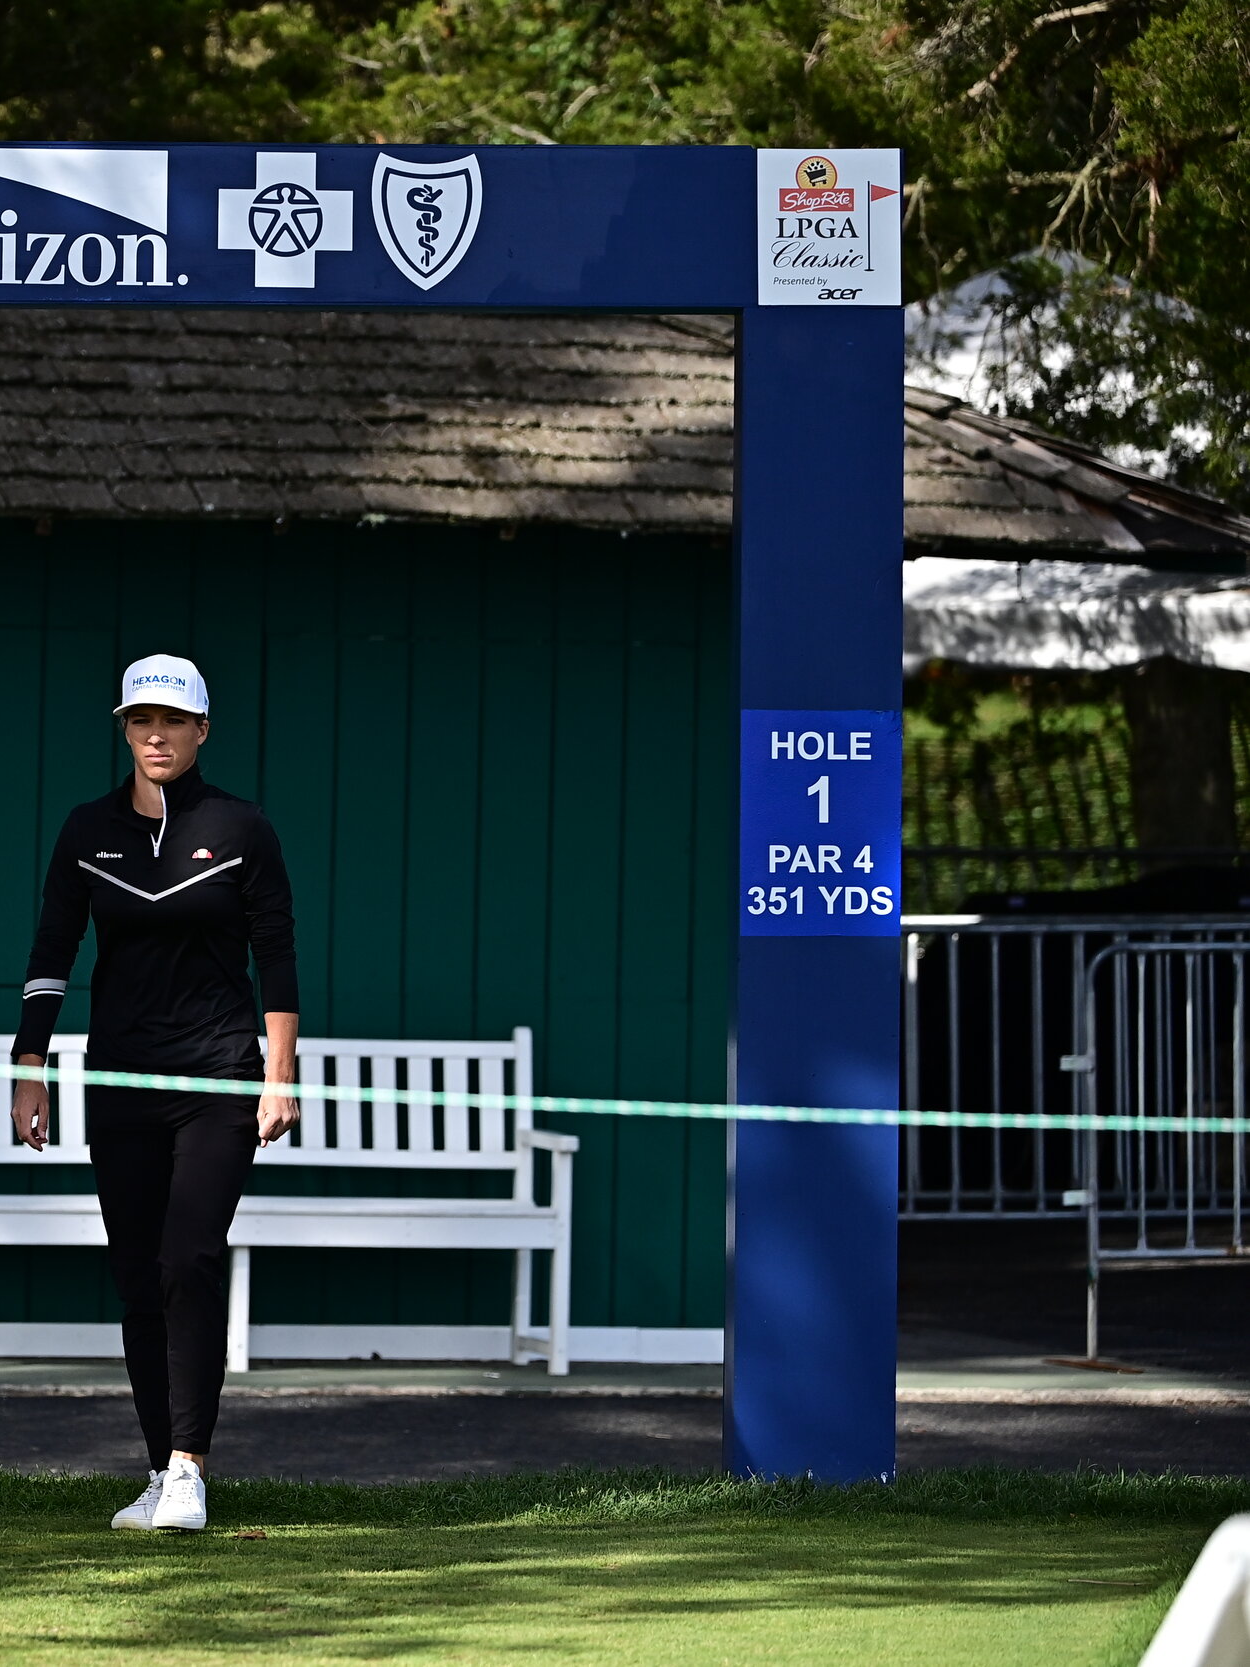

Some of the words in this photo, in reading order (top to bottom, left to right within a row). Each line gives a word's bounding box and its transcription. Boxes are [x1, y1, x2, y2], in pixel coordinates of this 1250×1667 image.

[783, 191, 851, 213] ShopRite
[776, 217, 860, 239] LPGA
[771, 240, 864, 269] Classic
[773, 277, 815, 285] Presented
[817, 277, 828, 287] by
[817, 288, 863, 300] acer
[132, 675, 186, 687] HEXAGON
[771, 731, 872, 761] HOLE
[807, 775, 830, 824] 1
[96, 851, 123, 859] ellesse
[768, 845, 843, 873] PAR
[853, 845, 874, 873] 4
[747, 886, 804, 915] 351
[818, 886, 894, 915] YDS
